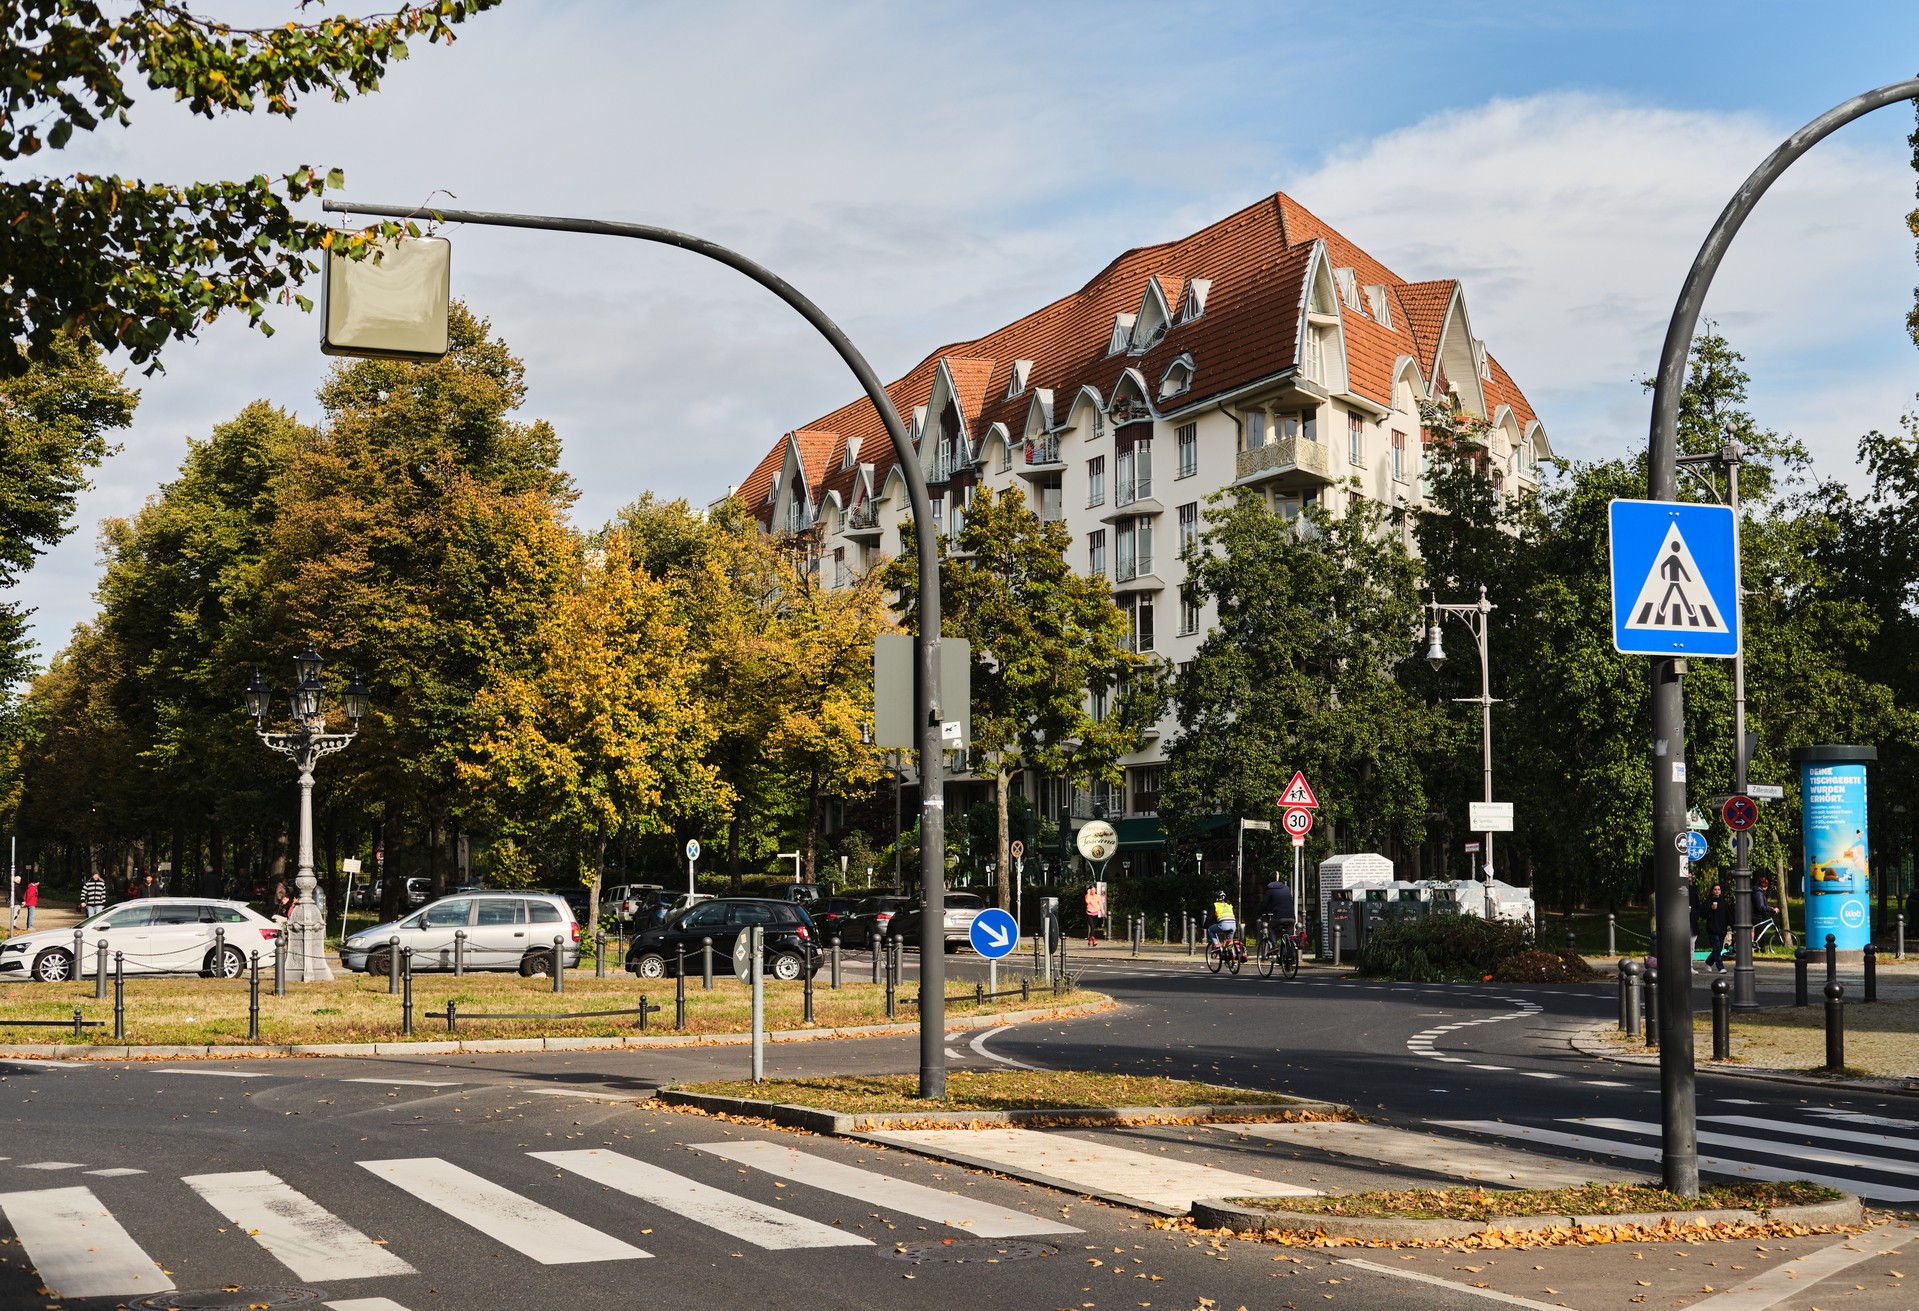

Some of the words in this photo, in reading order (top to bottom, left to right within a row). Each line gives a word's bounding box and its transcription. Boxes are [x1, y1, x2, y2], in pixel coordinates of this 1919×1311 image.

[1810, 768, 1833, 776] DEINE
[1810, 785, 1846, 793] WURDEN
[1810, 791, 1844, 803] ERHÖRT.
[1290, 815, 1306, 827] 30
[1080, 834, 1116, 847] Toscana
